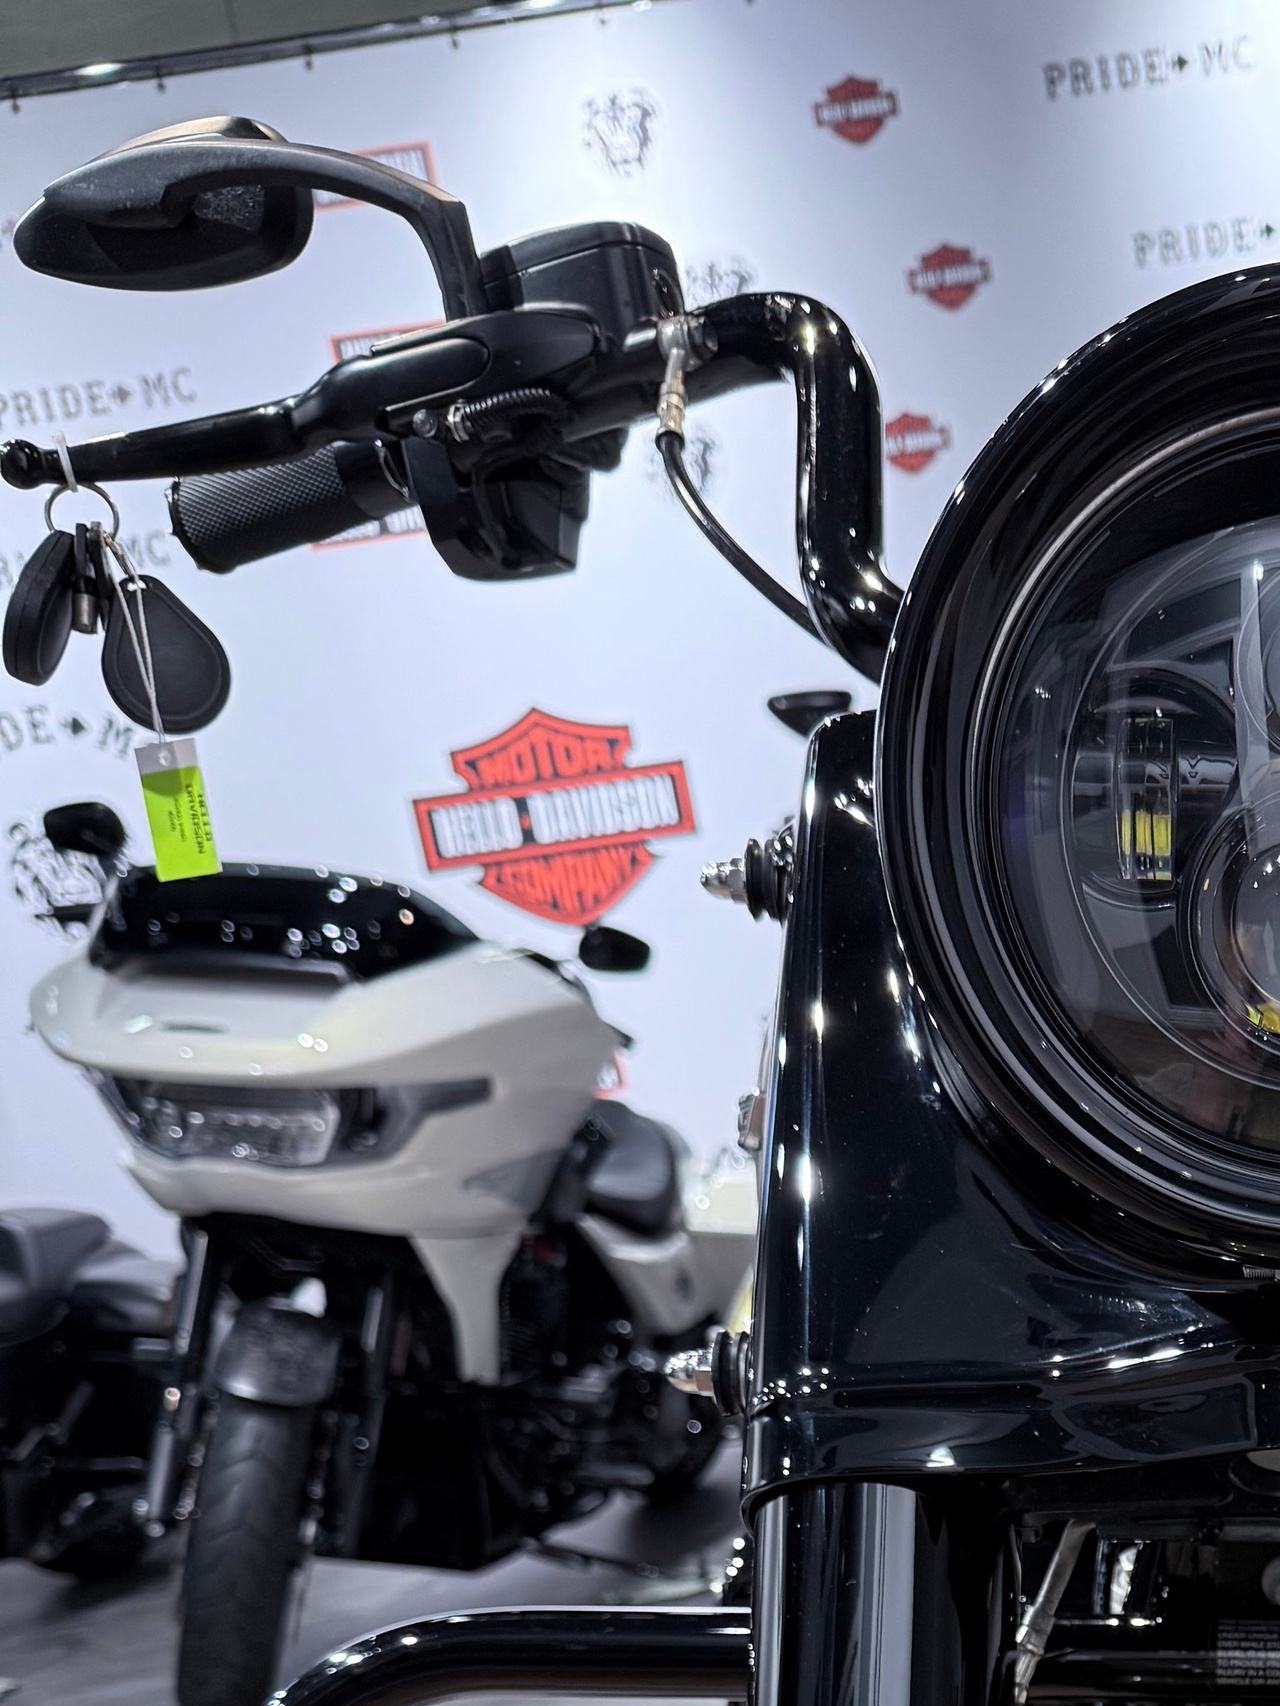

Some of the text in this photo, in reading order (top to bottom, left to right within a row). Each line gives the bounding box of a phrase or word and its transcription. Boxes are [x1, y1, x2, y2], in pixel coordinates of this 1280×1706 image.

[1043, 34, 1255, 100] PRIDE MC
[1132, 216, 1256, 269] PRIDE
[140, 366, 197, 408] MC
[477, 726, 610, 788] MOTOR
